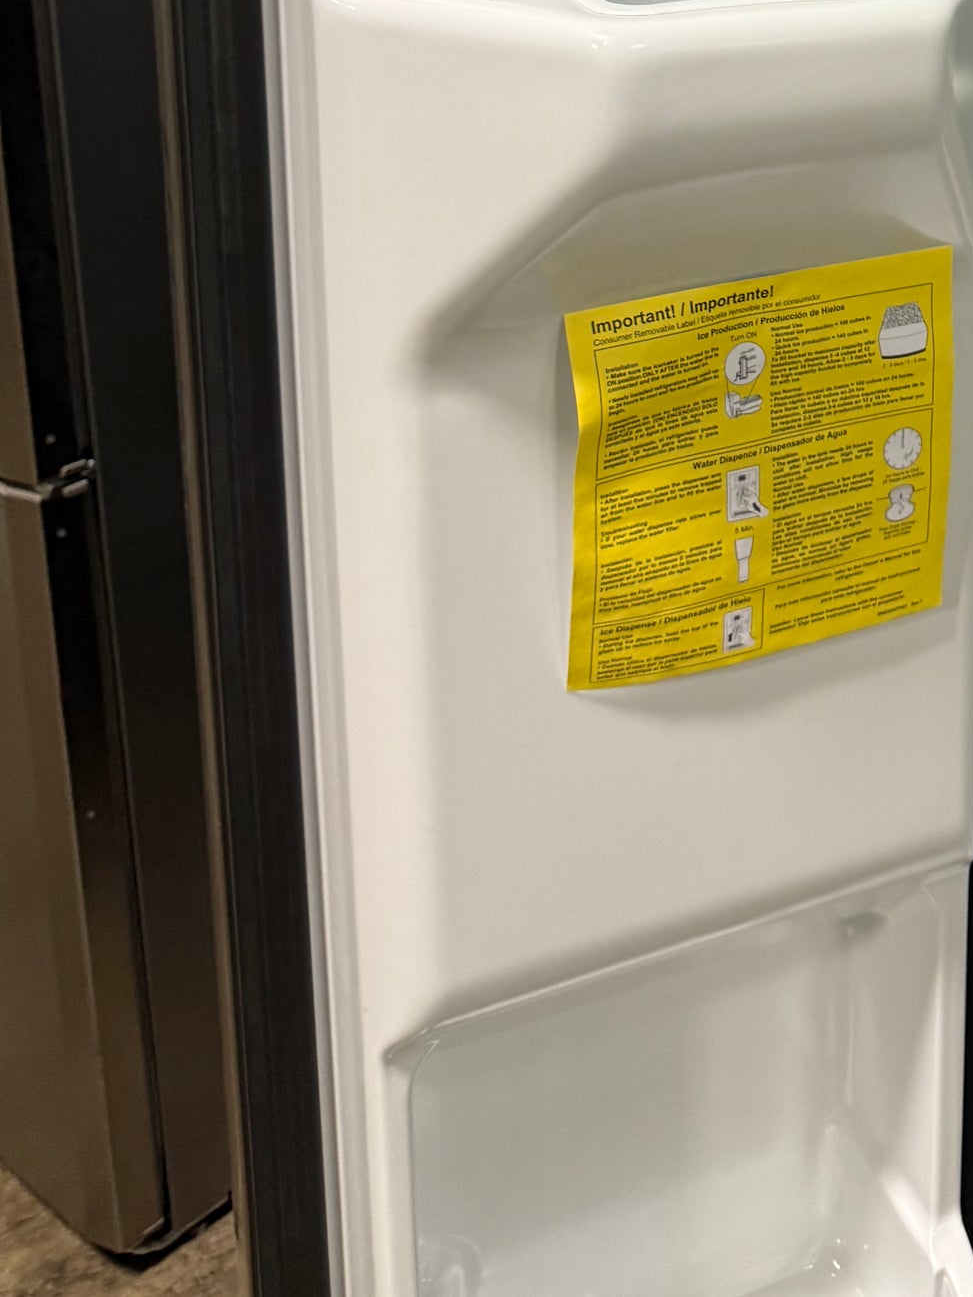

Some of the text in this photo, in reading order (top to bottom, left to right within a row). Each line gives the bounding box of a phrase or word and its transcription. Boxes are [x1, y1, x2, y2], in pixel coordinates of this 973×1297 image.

[591, 285, 774, 335] Important! / Importante!
[593, 333, 632, 347] Consumer
[634, 324, 675, 338] Removable
[676, 318, 695, 329] Label
[701, 311, 726, 323] Etiqueta
[762, 302, 772, 311] por
[775, 299, 781, 307] el
[783, 293, 820, 306] consumidor
[697, 331, 708, 340] Ice
[710, 320, 753, 336] Production
[760, 311, 807, 325] Producción
[809, 308, 819, 316] de
[821, 304, 844, 314] Hielos
[731, 330, 757, 342] Turn ON
[692, 458, 717, 469] Water
[763, 436, 812, 453] Dispensador
[815, 433, 825, 441] de
[827, 429, 847, 440] Agua
[600, 628, 614, 636] Ice
[664, 605, 716, 624] Dispensador
[719, 602, 729, 610] de
[731, 596, 751, 607] Hielo
